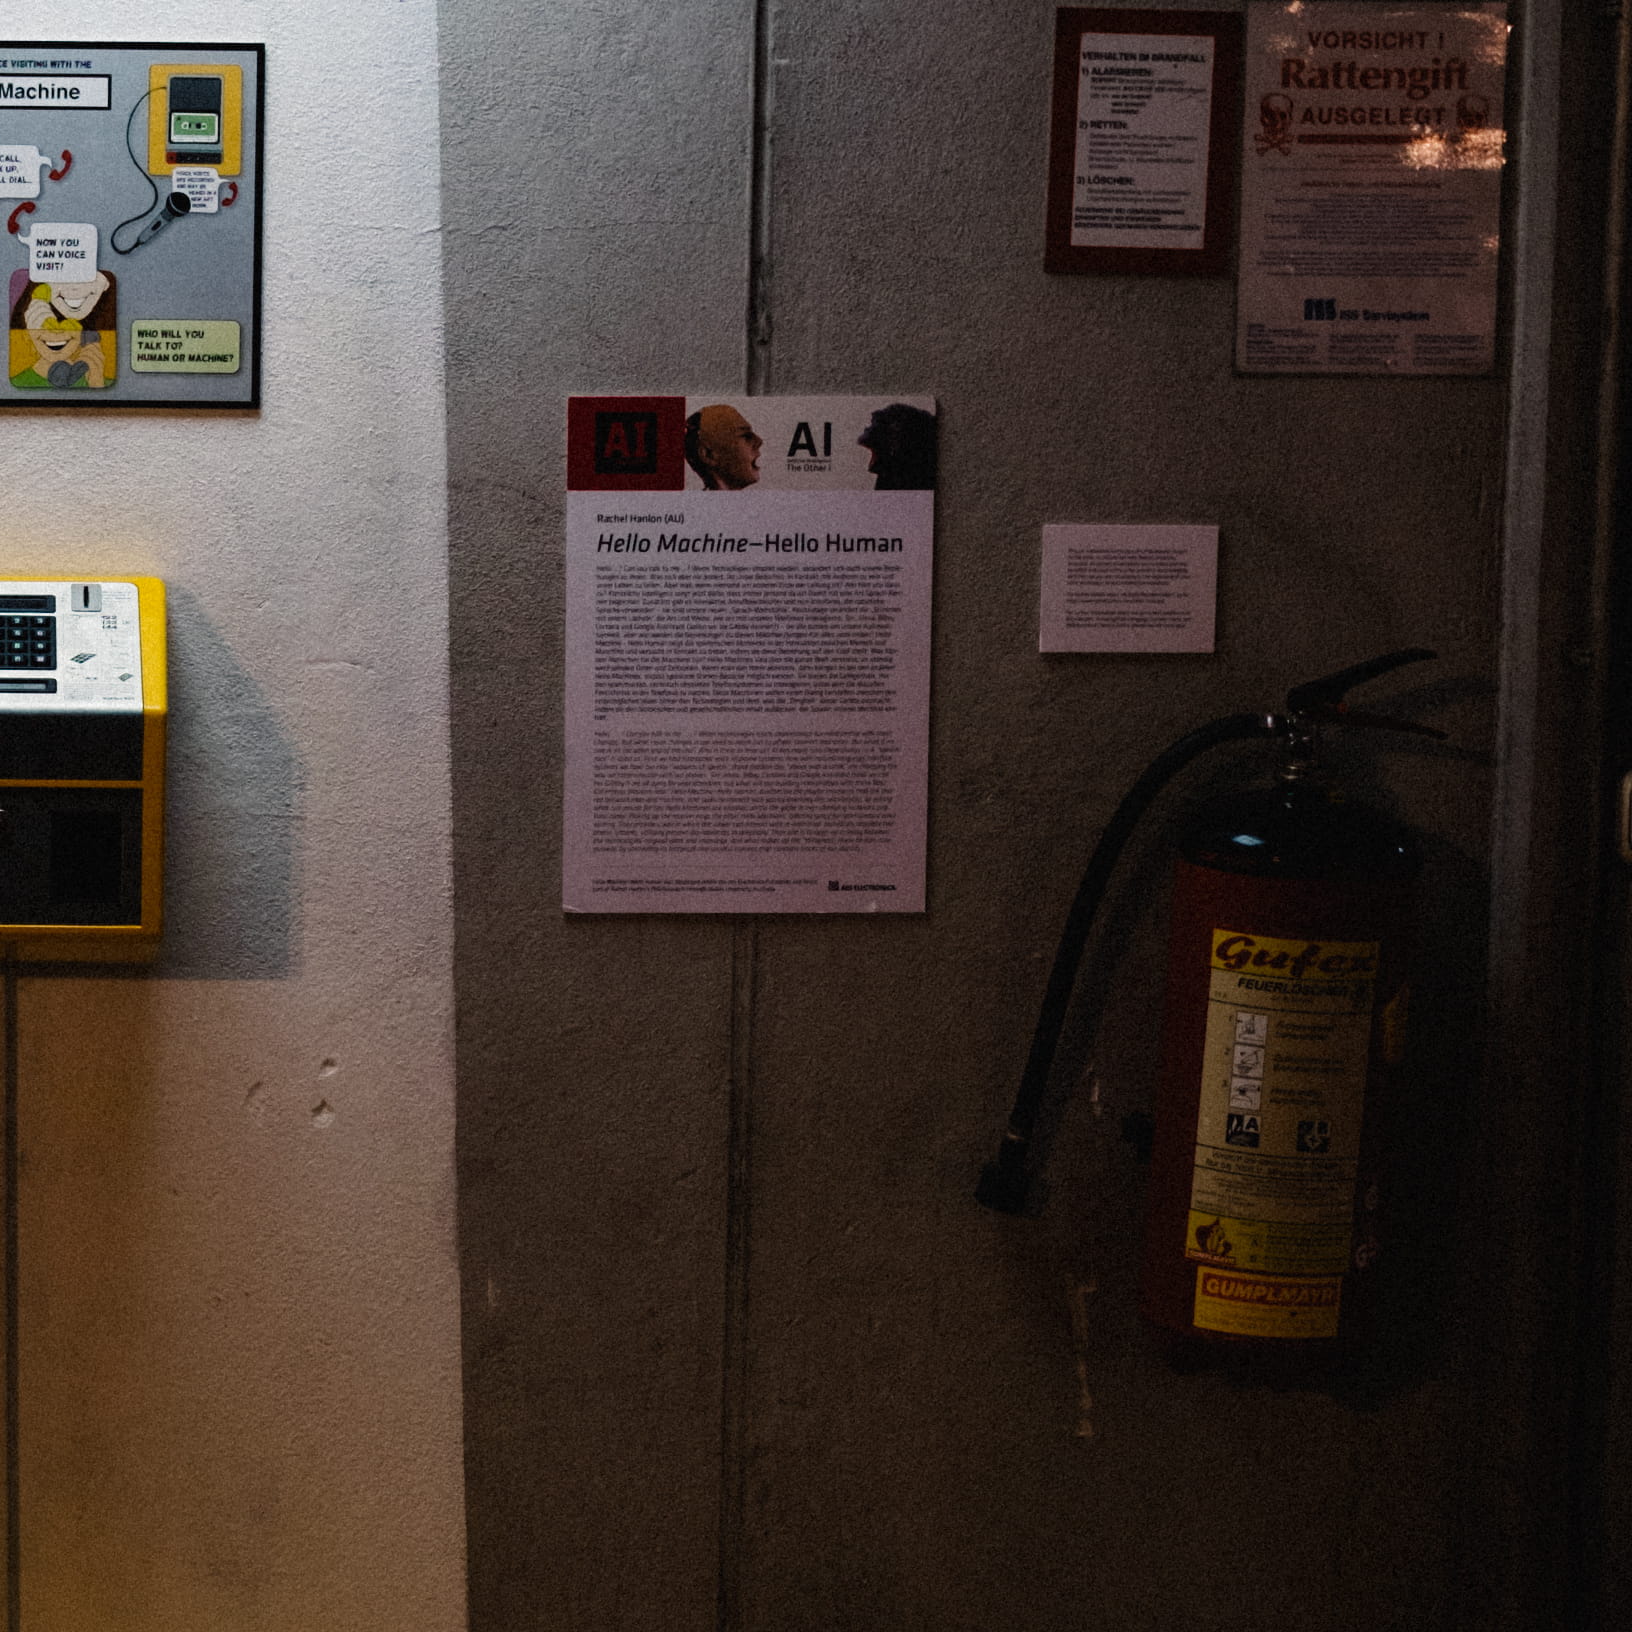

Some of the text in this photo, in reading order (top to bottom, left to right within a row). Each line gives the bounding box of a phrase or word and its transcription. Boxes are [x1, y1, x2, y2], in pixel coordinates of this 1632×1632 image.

[1308, 31, 1429, 50] VORSICHT
[1281, 57, 1469, 100] Rattengift
[1301, 107, 1446, 126] AUSGELEGT
[61, 238, 80, 247] YOU
[36, 250, 86, 259] CAN VOICE
[137, 330, 205, 338] WHO WILL YOU
[138, 342, 162, 350] TALK
[172, 354, 185, 362] OR
[188, 354, 234, 363] MACHINE?
[787, 422, 832, 457] AI
[597, 533, 650, 553] Hello
[826, 533, 903, 553] Human
